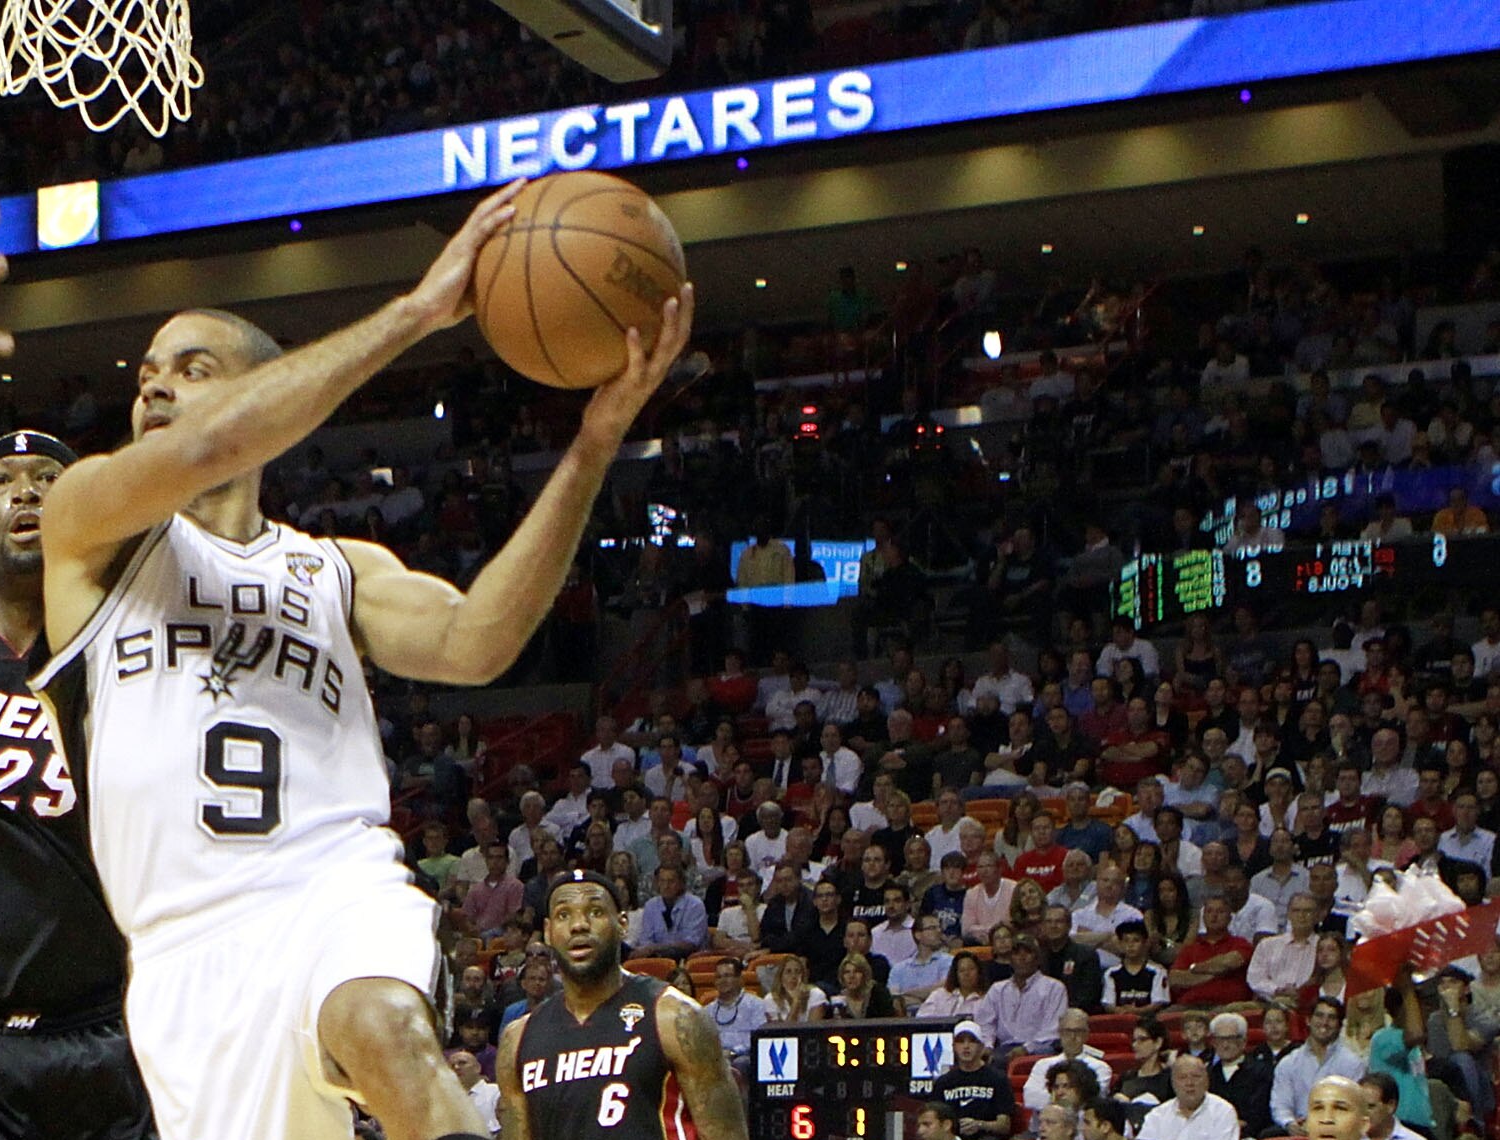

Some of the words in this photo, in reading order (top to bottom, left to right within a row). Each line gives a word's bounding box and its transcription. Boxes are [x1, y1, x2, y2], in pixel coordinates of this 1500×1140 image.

[442, 71, 875, 186] NECTARES
[188, 575, 311, 628] LOS
[115, 622, 343, 716] SPURS
[200, 720, 284, 836] 9
[522, 1059, 548, 1093] EL
[555, 1036, 642, 1083] HEAT
[828, 1036, 909, 1067] 7:11
[597, 1083, 630, 1127] 6
[767, 1084, 795, 1097] HEAT
[943, 1085, 994, 1101] WITNESS
[790, 1105, 815, 1140] 6
[856, 1107, 866, 1136] 1
